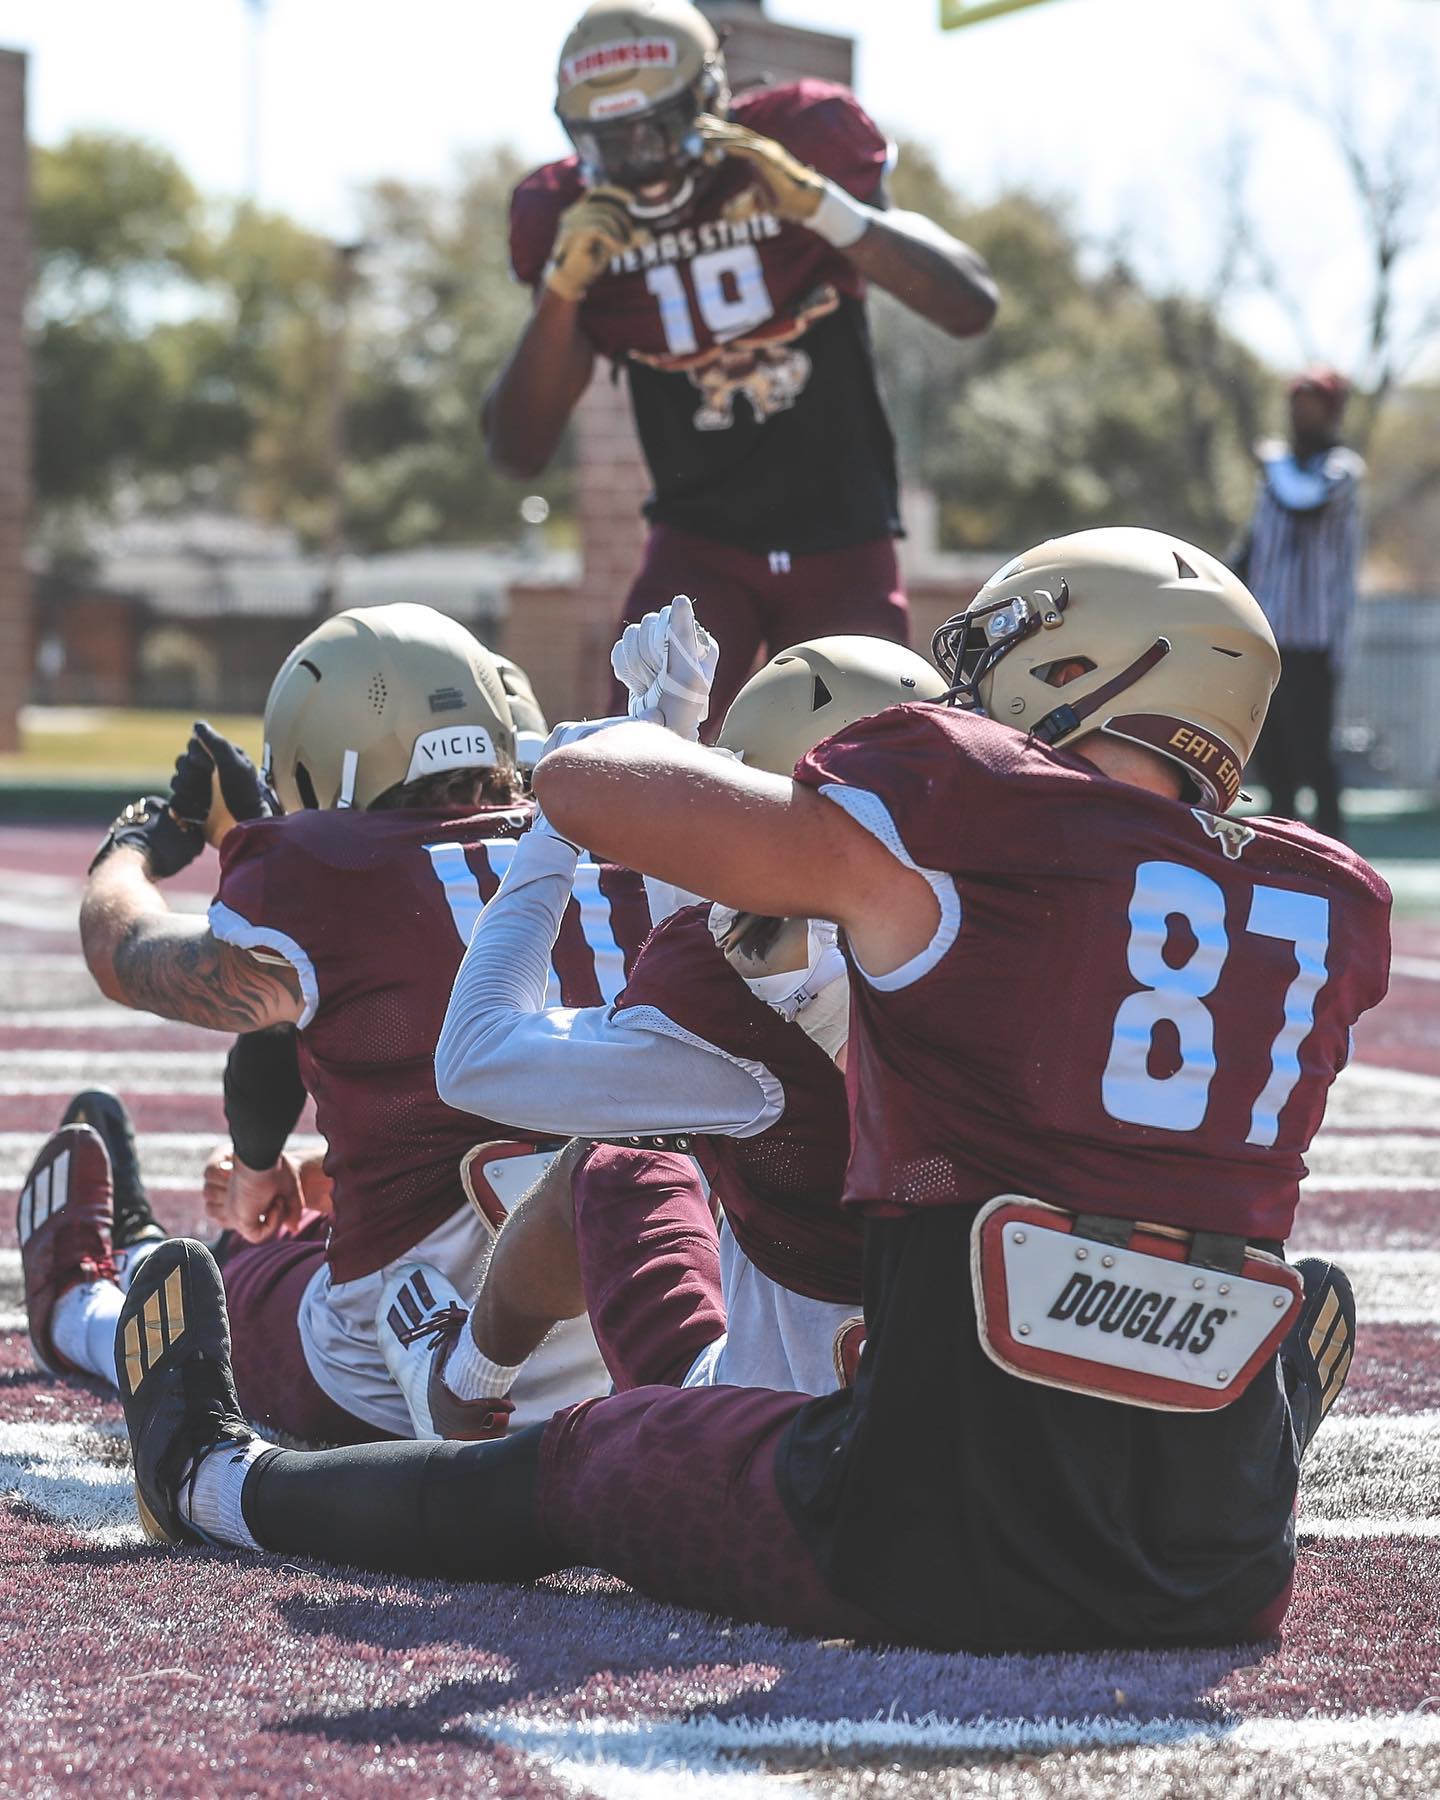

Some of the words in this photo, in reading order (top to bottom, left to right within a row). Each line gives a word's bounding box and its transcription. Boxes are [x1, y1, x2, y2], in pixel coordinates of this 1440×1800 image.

[421, 736, 487, 761] VICIS
[1168, 727, 1219, 763] EAT
[1102, 860, 1329, 1147] 87
[1047, 1271, 1228, 1355] DOUGLAS
